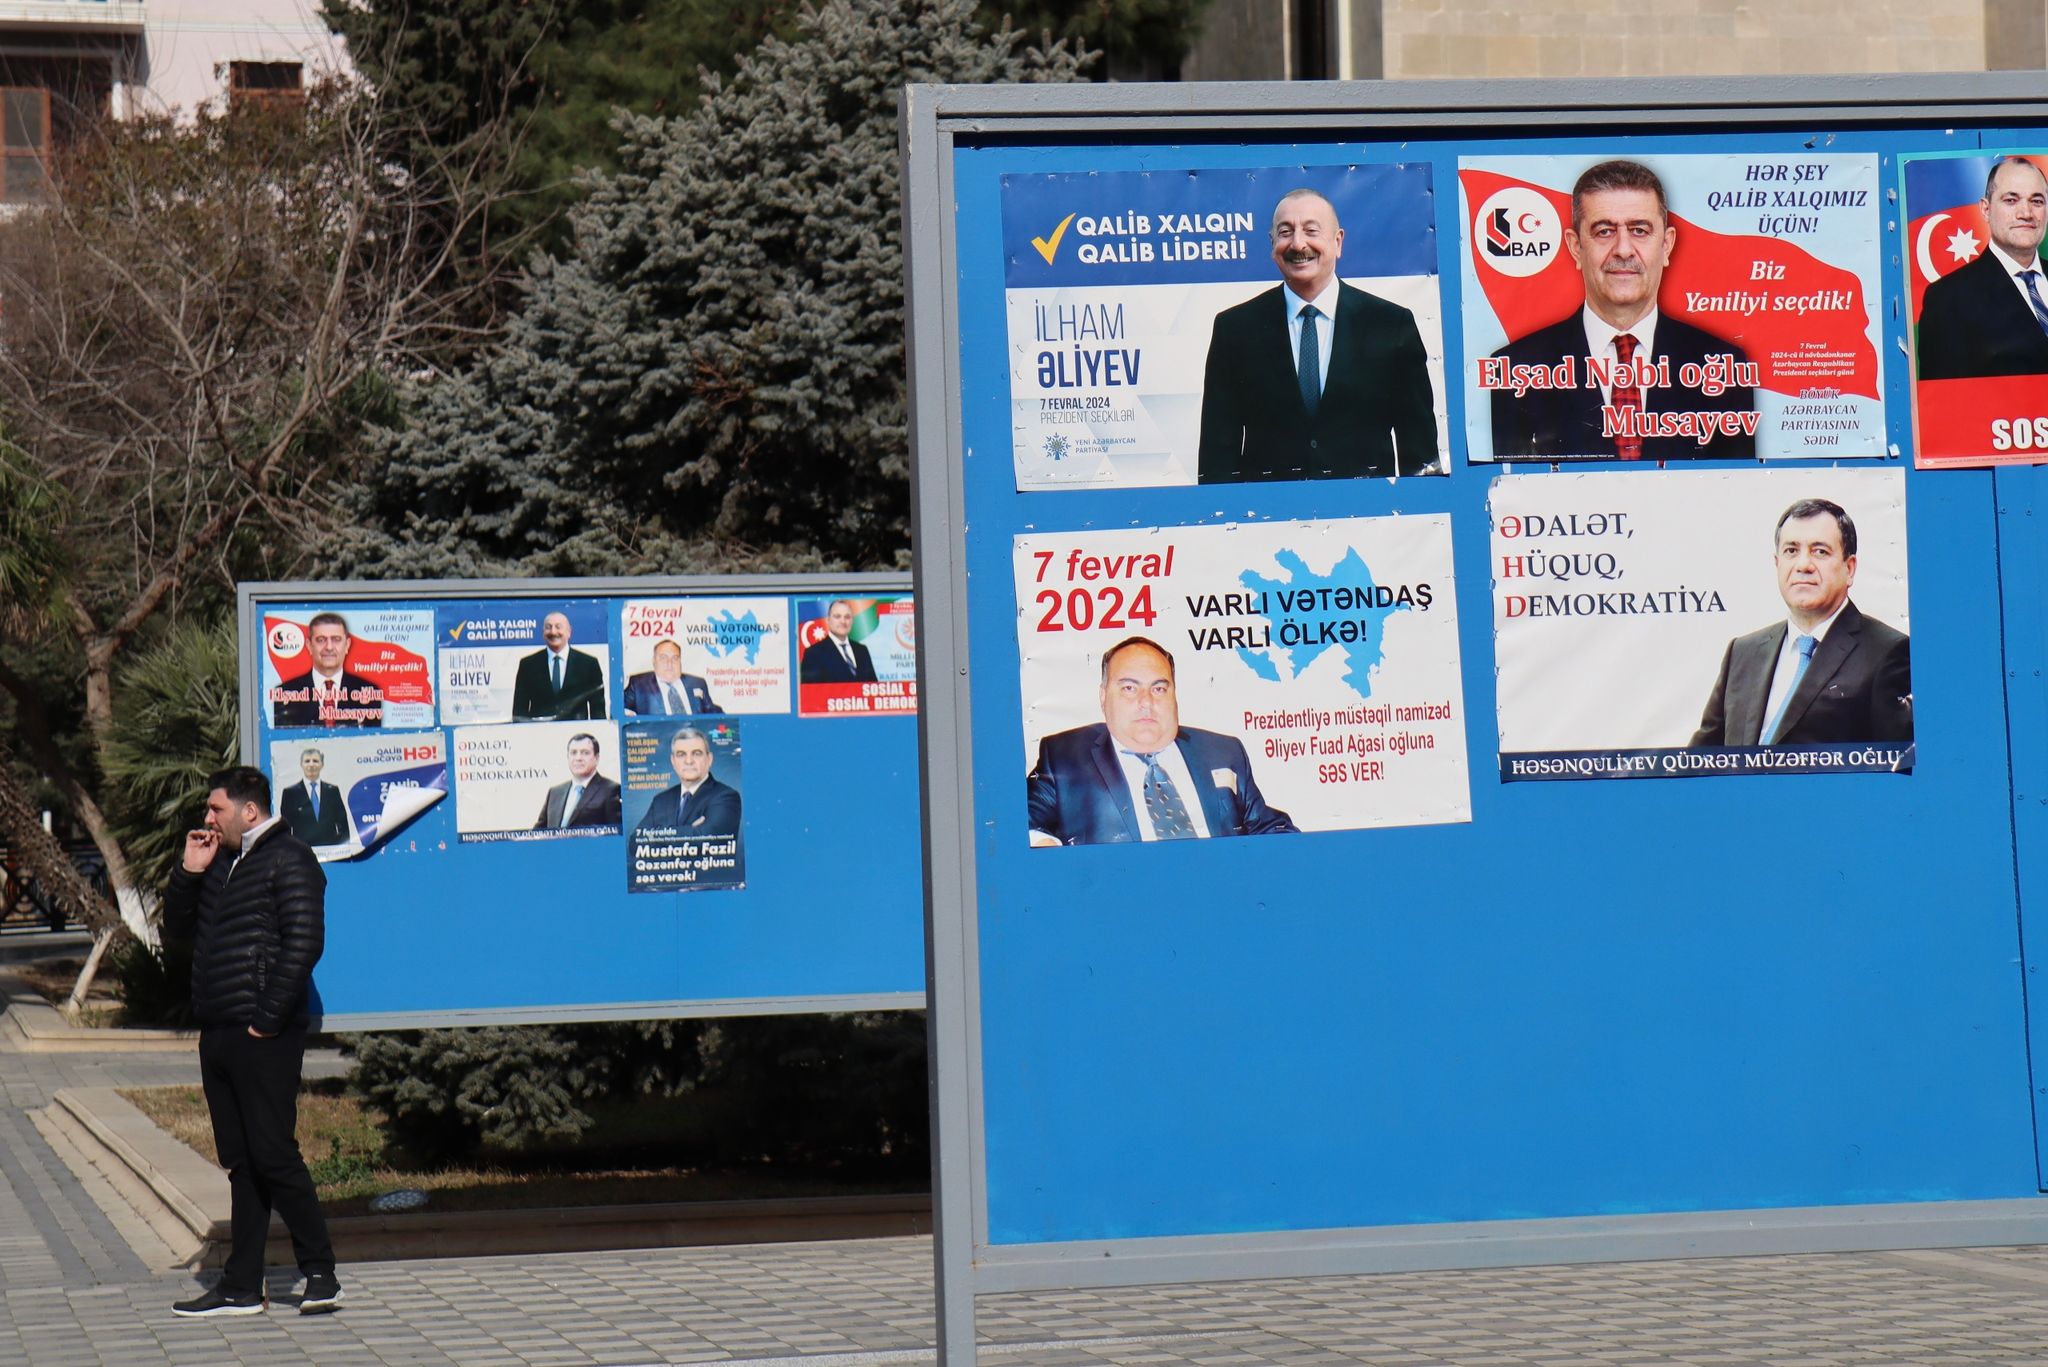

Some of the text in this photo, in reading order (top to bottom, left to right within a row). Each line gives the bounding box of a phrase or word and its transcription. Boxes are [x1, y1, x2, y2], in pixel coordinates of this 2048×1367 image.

[1746, 165, 1829, 185] HƏR ŞEY
[1707, 188, 1867, 211] QALİB XALQIMIZ
[1077, 210, 1253, 236] QALİB XALQIN
[1758, 214, 1819, 237] ÜÇÜN!
[1078, 234, 1246, 264] QALİB LİDERİ!
[1512, 243, 1550, 257] BAP
[1749, 260, 1785, 280] Biz
[1685, 290, 1853, 316] Yeniliyi seçdik!
[1036, 299, 1124, 341] İLHAM
[1038, 344, 1140, 388] ƏLİYEV
[1476, 354, 1760, 398] Elşad Nəbi oğlu
[1800, 387, 1840, 399] BÖYÜK
[1040, 397, 1110, 410] 7 FEVRAL 2024
[1782, 405, 1857, 415] AZƏRBAYCAN
[1041, 408, 1135, 424] PREZİDENT SEÇKİLƏRİ
[1601, 404, 1761, 445] Musayev
[1781, 418, 1859, 431] PARTİYASININ
[1803, 433, 1839, 446] SƏDRİ
[1500, 513, 1634, 539] ƏDALƏT,
[1034, 545, 1174, 582] 7 fevral
[1502, 549, 1624, 581] HÜQUQ,
[1036, 585, 1157, 632] 2024
[1186, 584, 1433, 618] VARLI VƏTƏNDAŞ
[1504, 585, 1727, 618] DEMOKRATİYA
[629, 606, 682, 618] 7 fevral
[467, 618, 536, 629] QALİB XALQIN
[630, 620, 675, 636] 2024
[686, 622, 780, 634] VARLI VƏTƏNDAŞ
[467, 629, 497, 641] QALİB
[687, 635, 718, 645] VARLI
[1188, 619, 1367, 651] VARLI ÖLKƏ!
[451, 669, 490, 686] ƏLİYEV
[862, 682, 905, 696] SOSİAL
[827, 696, 870, 711] SOSİAL
[319, 705, 384, 722] Musayev
[1244, 700, 1450, 731] Prezidentliyə müstəqil namizəd
[459, 739, 511, 751] ƏDALƏT,
[1265, 731, 1434, 762] Əliyev Fuad Ağasi oğluna
[1511, 747, 1900, 775] HƏSƏNQULİYEV QÜDRƏT MÜZƏFFƏR OĞLU
[460, 767, 548, 781] DEMOKRATİYA
[1319, 762, 1384, 783] SƏS VER!
[636, 841, 736, 858] Mustafa Fazil
[636, 857, 735, 871] Qəzənfər oğluna
[636, 870, 696, 883] səs verək!
